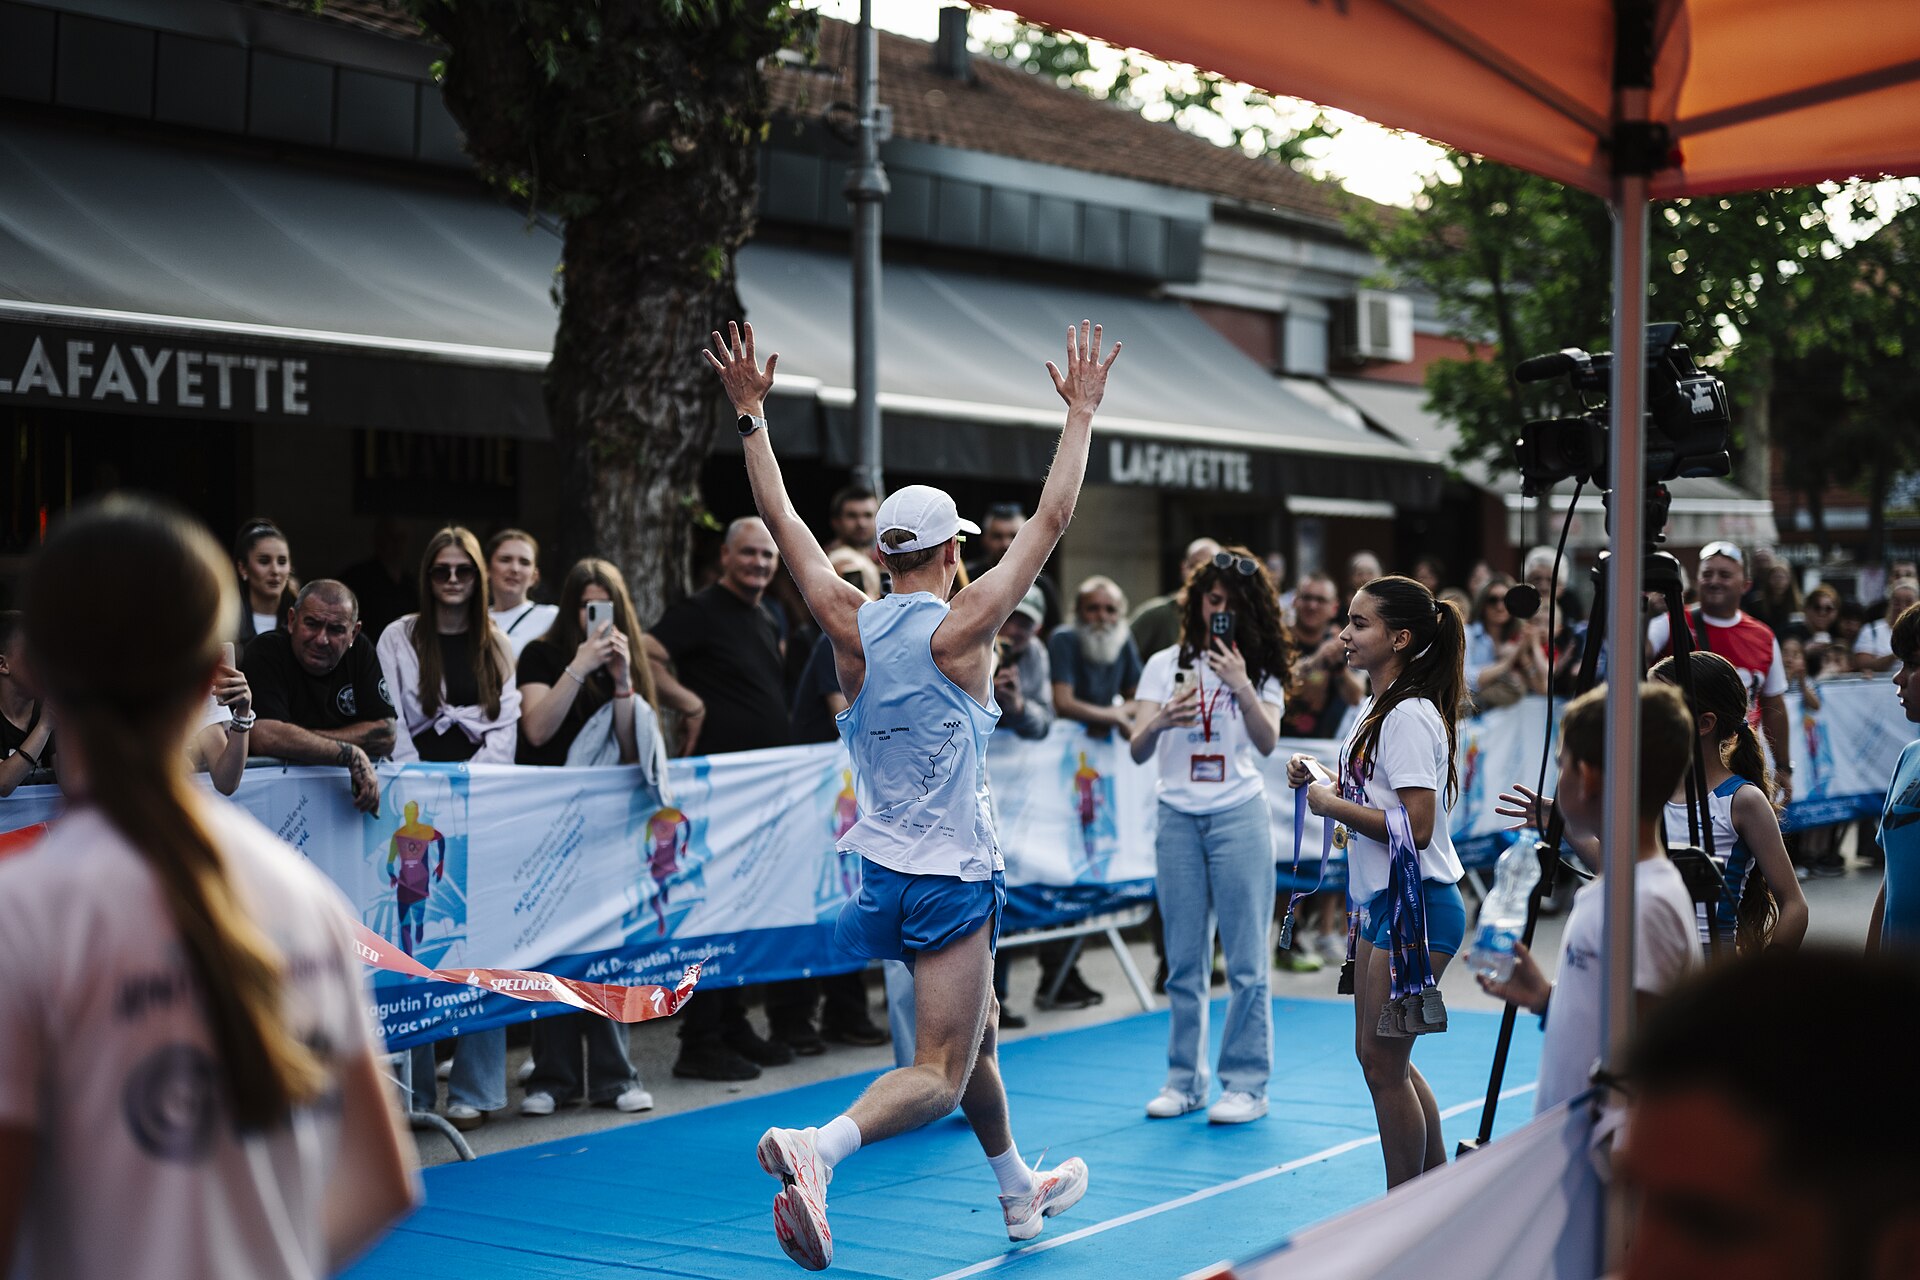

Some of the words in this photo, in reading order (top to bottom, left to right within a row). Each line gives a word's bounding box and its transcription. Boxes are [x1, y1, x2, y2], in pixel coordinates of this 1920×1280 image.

[1108, 440, 1252, 492] LAFAYETTE
[277, 794, 309, 838] mašević
[586, 959, 608, 978] AK
[609, 951, 671, 974] Dragutin
[603, 972, 664, 987] etrovac
[490, 978, 554, 991] SPECIALIZ
[367, 995, 422, 1020] agutin
[424, 985, 490, 1010] Tomaše
